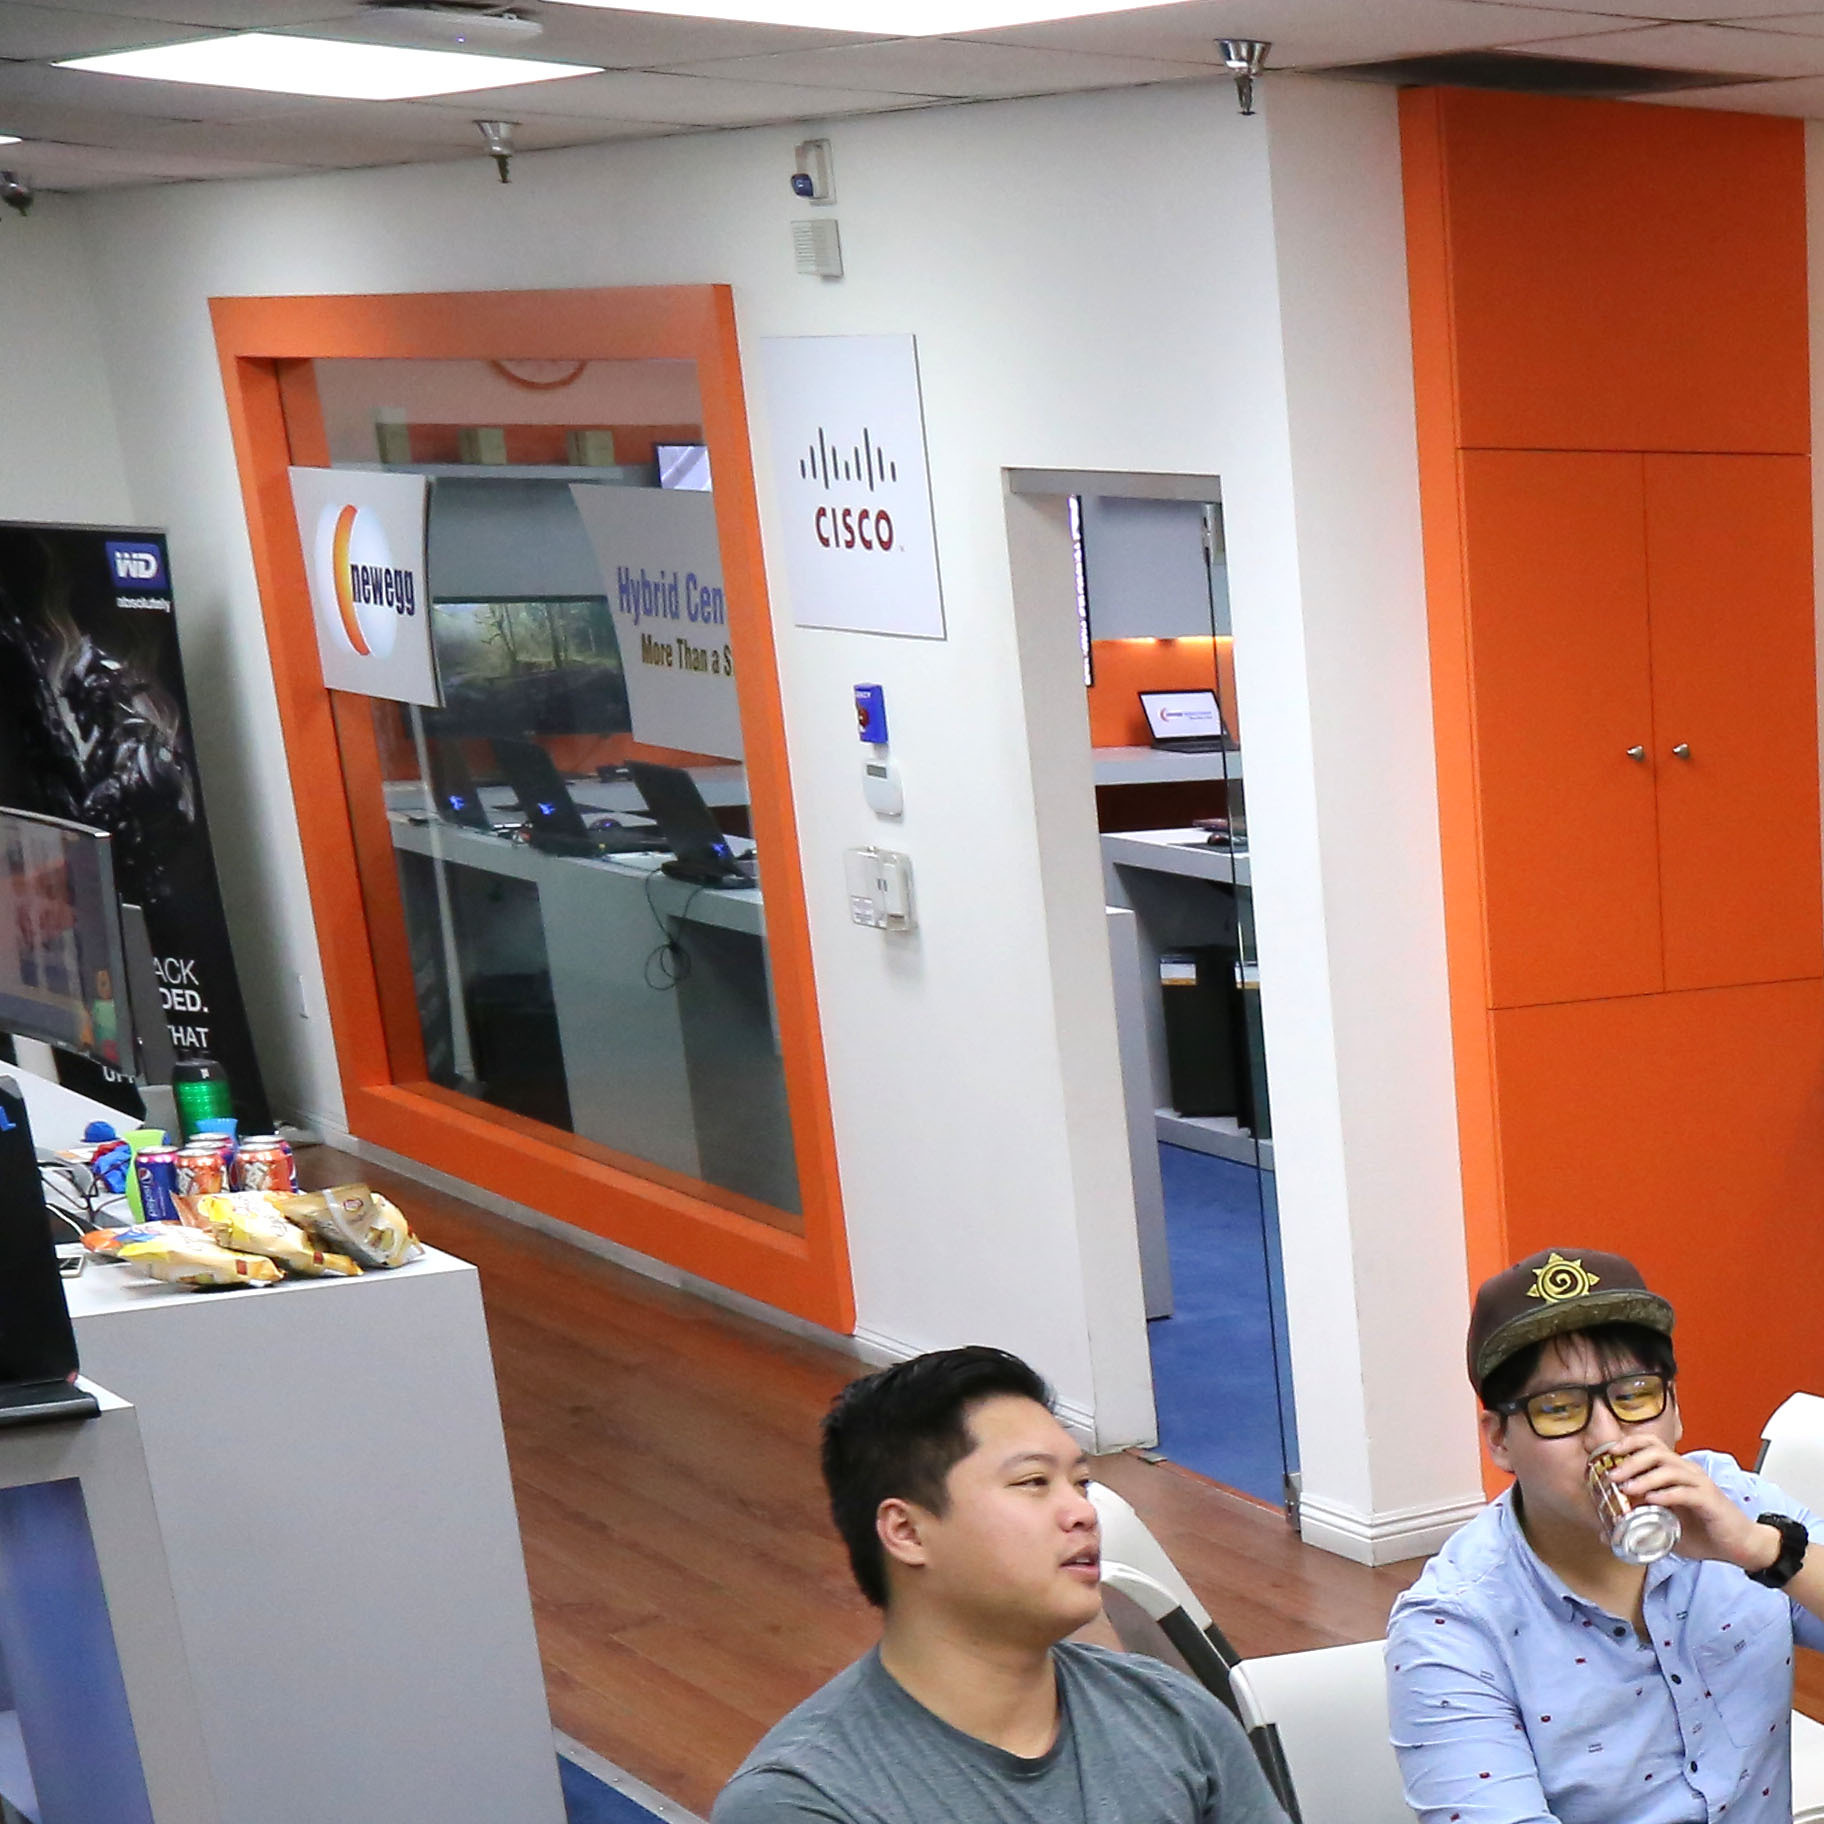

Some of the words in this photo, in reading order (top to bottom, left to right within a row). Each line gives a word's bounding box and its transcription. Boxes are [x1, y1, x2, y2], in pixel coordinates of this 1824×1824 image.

[815, 506, 894, 552] CISCO
[115, 552, 158, 579] WD
[350, 562, 415, 617] newegg
[616, 565, 680, 626] Hybrid
[640, 632, 673, 668] More
[676, 637, 709, 675] Than
[710, 650, 720, 674] a
